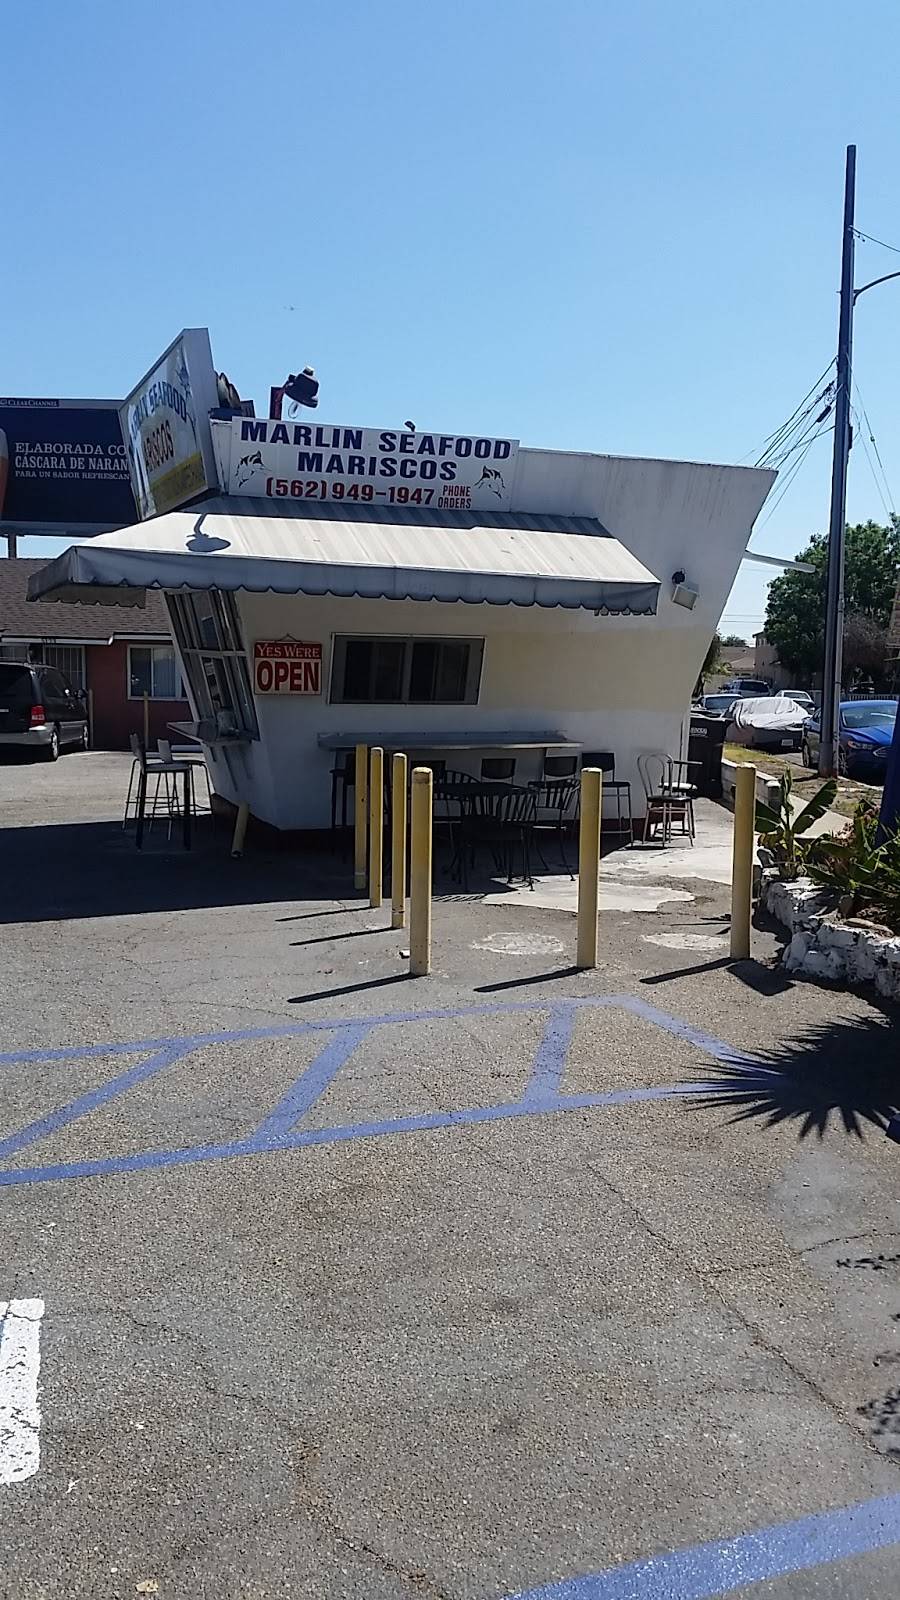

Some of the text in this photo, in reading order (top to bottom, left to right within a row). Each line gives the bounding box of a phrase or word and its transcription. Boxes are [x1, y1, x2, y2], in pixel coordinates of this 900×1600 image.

[148, 381, 187, 423] SEAFOOD
[15, 442, 104, 455] ELABORADA
[144, 419, 175, 473] ARISCOS
[241, 420, 511, 459] MARLIN SEAFOOD
[70, 457, 85, 469] DE
[297, 451, 458, 481] MARISCOS
[15, 470, 37, 478] PARA
[39, 470, 50, 478] UN
[53, 471, 80, 479] SABOR
[442, 484, 472, 498] PHONE
[437, 496, 472, 509] ORDERS
[256, 660, 319, 691] OPEN
